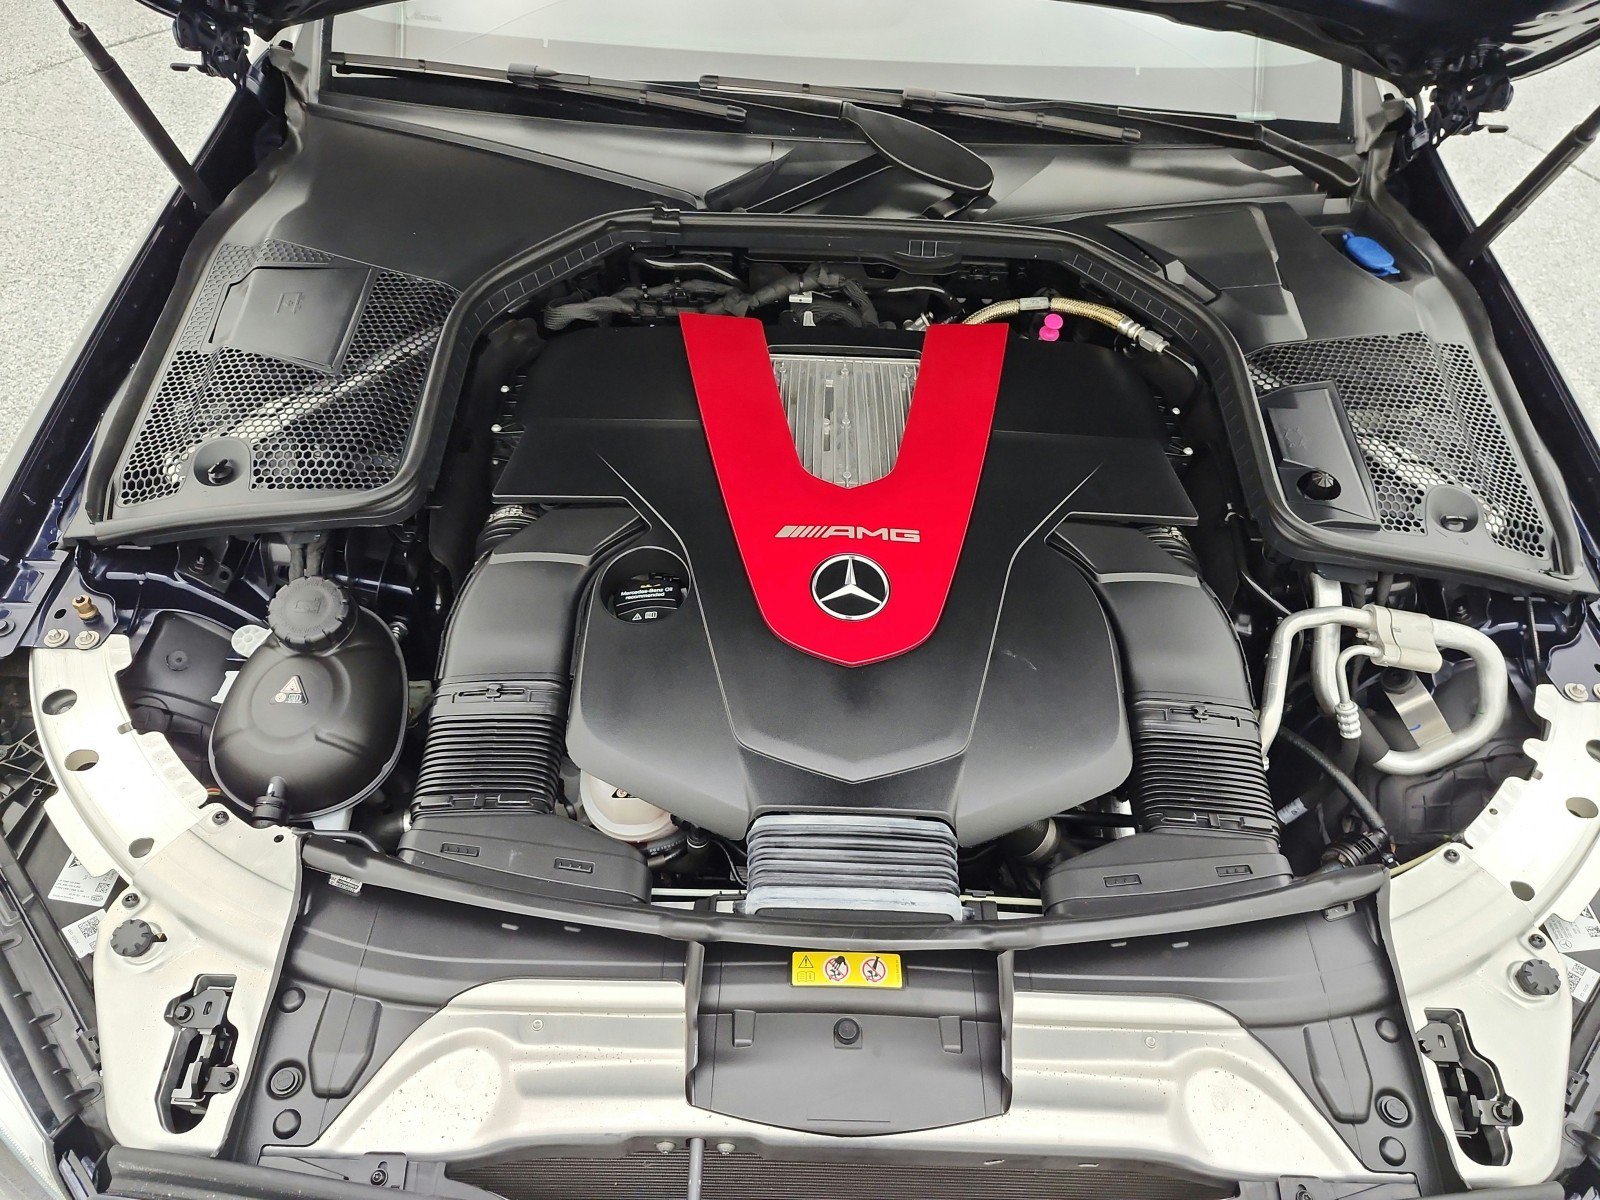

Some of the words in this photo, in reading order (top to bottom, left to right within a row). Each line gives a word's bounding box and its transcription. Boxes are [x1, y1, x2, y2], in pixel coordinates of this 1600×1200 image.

[821, 525, 921, 543] AMG
[620, 588, 664, 596] Mercedes-Benz
[625, 592, 665, 600] recommended
